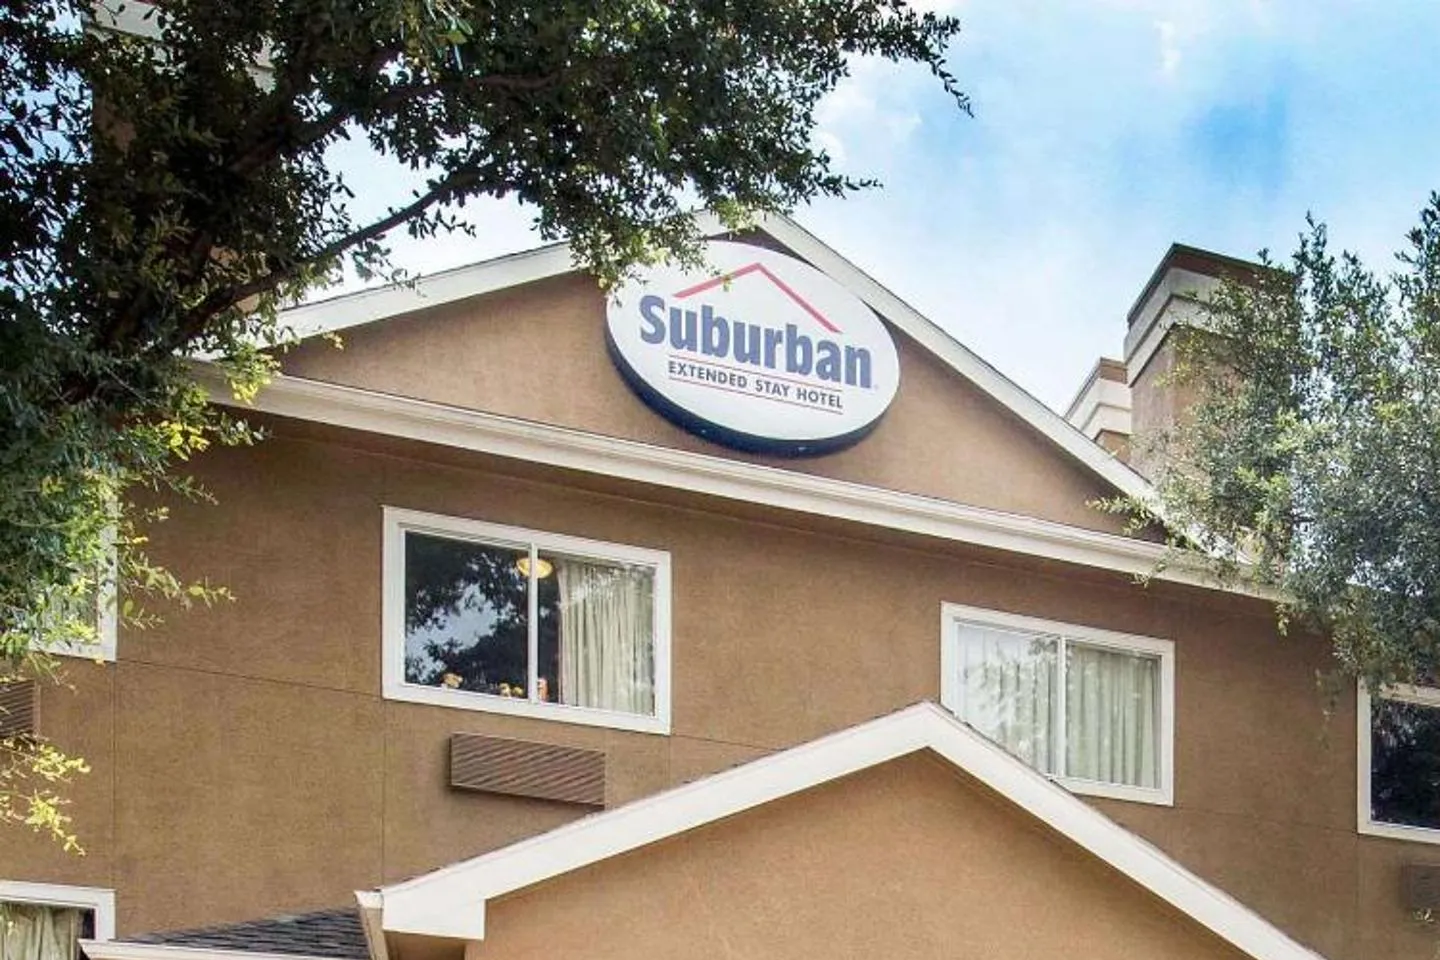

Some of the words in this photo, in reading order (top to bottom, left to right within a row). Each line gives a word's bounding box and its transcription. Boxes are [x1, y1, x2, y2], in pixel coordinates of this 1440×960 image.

[639, 295, 872, 389] Suburban
[668, 361, 748, 389] EXTENDED
[755, 379, 791, 398] STAY
[796, 387, 844, 410] HOTEL
